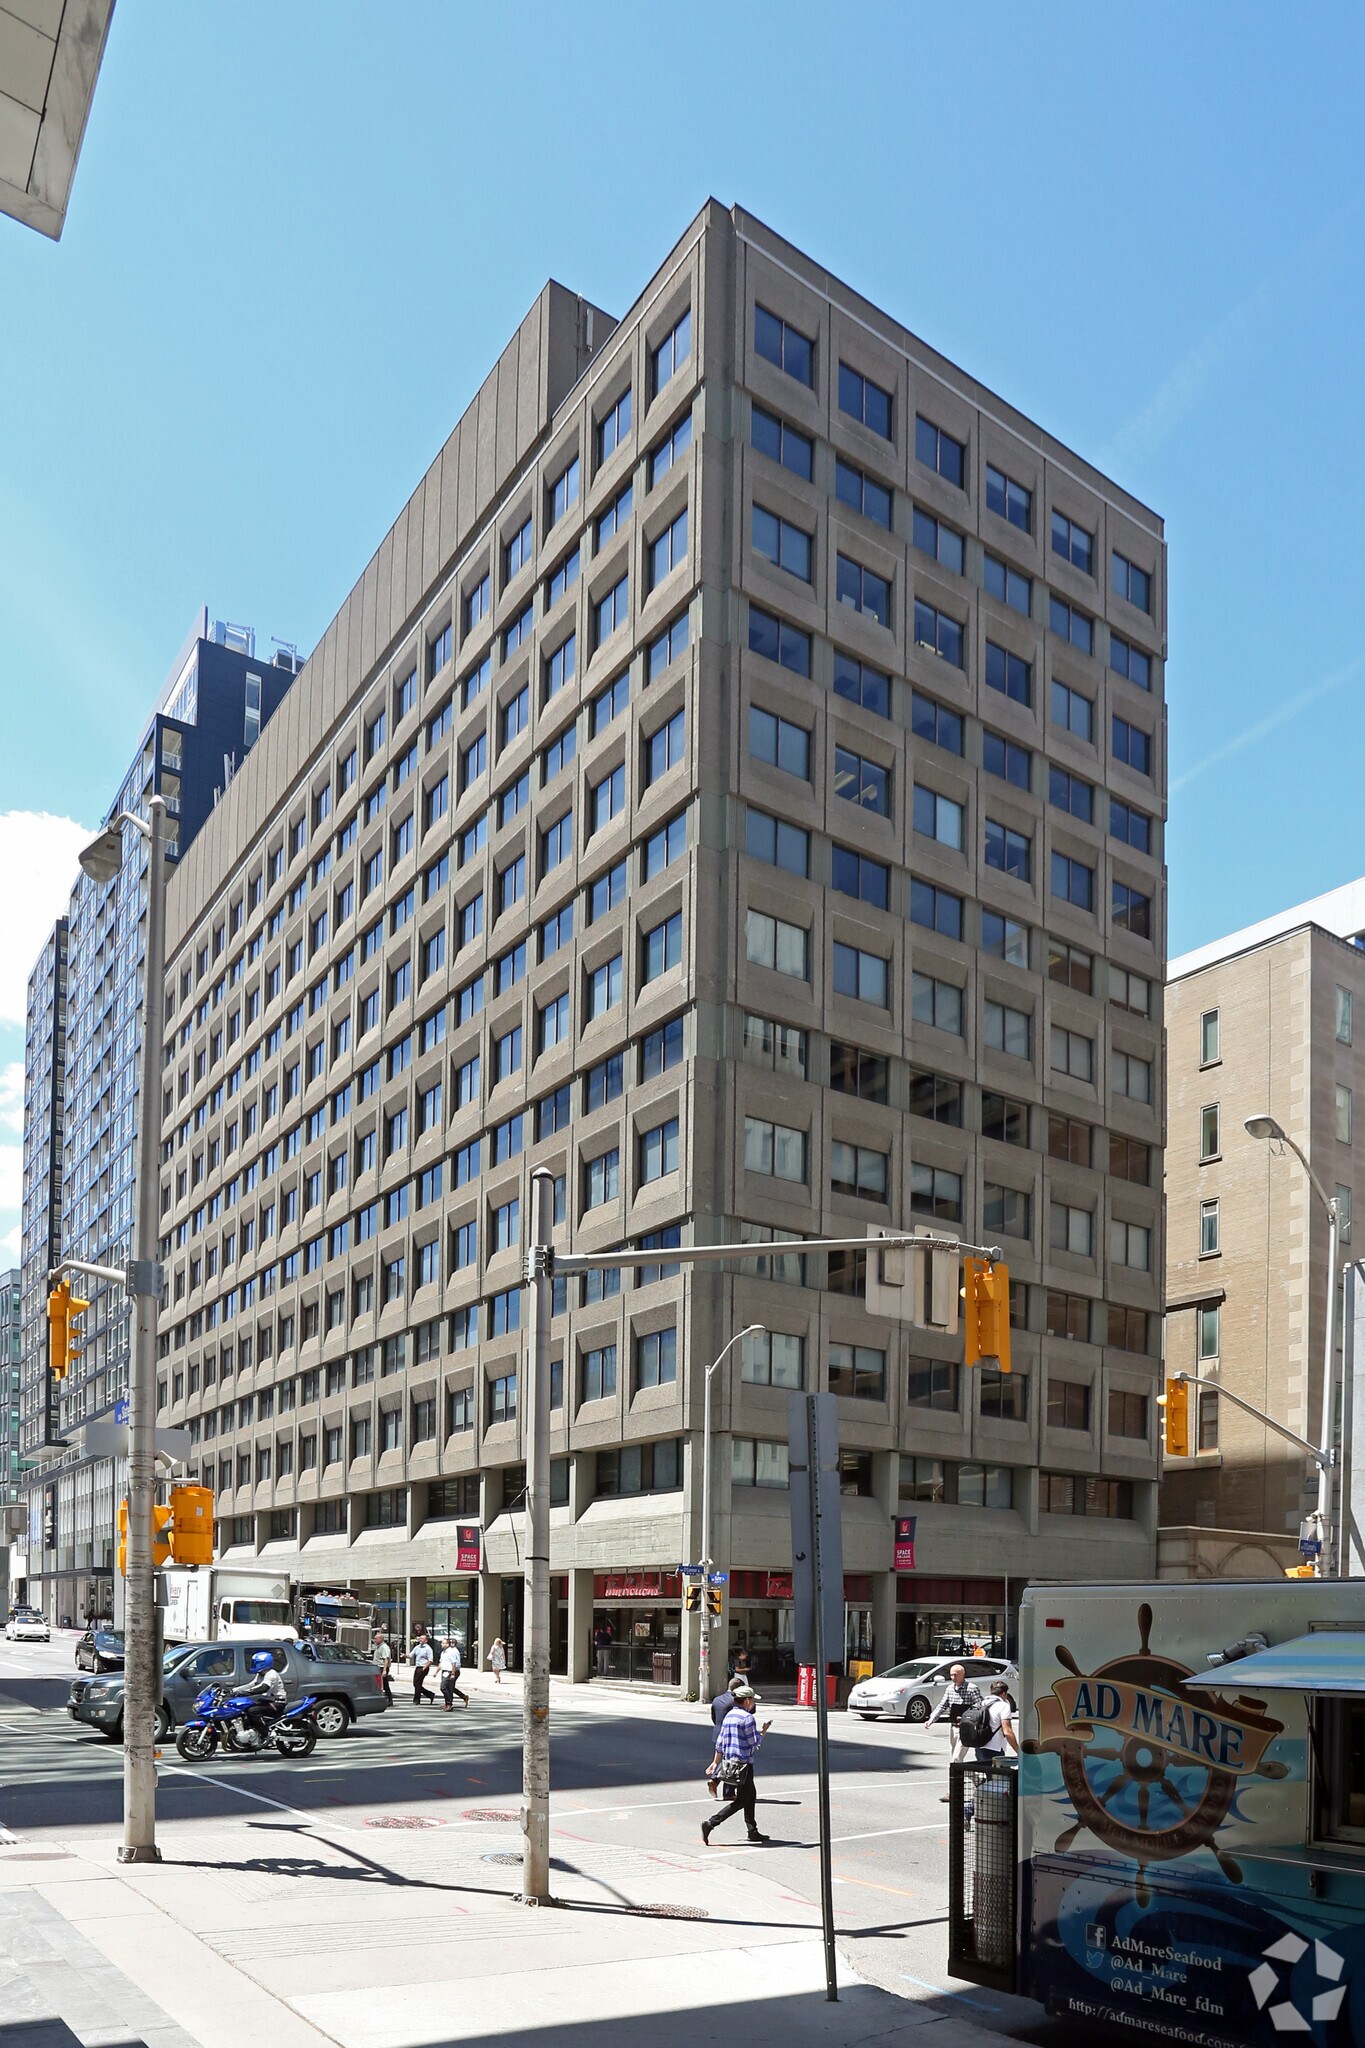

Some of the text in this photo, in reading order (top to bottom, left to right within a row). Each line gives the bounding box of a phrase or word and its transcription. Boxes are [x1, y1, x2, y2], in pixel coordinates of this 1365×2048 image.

[1071, 1683, 1244, 1769] AD MARE
[1110, 1954, 1188, 1984] @Ad_Mare
[1111, 1935, 1223, 1971] AdMareSeafood
[1110, 1976, 1225, 2016] @Ad_Mare_fdm
